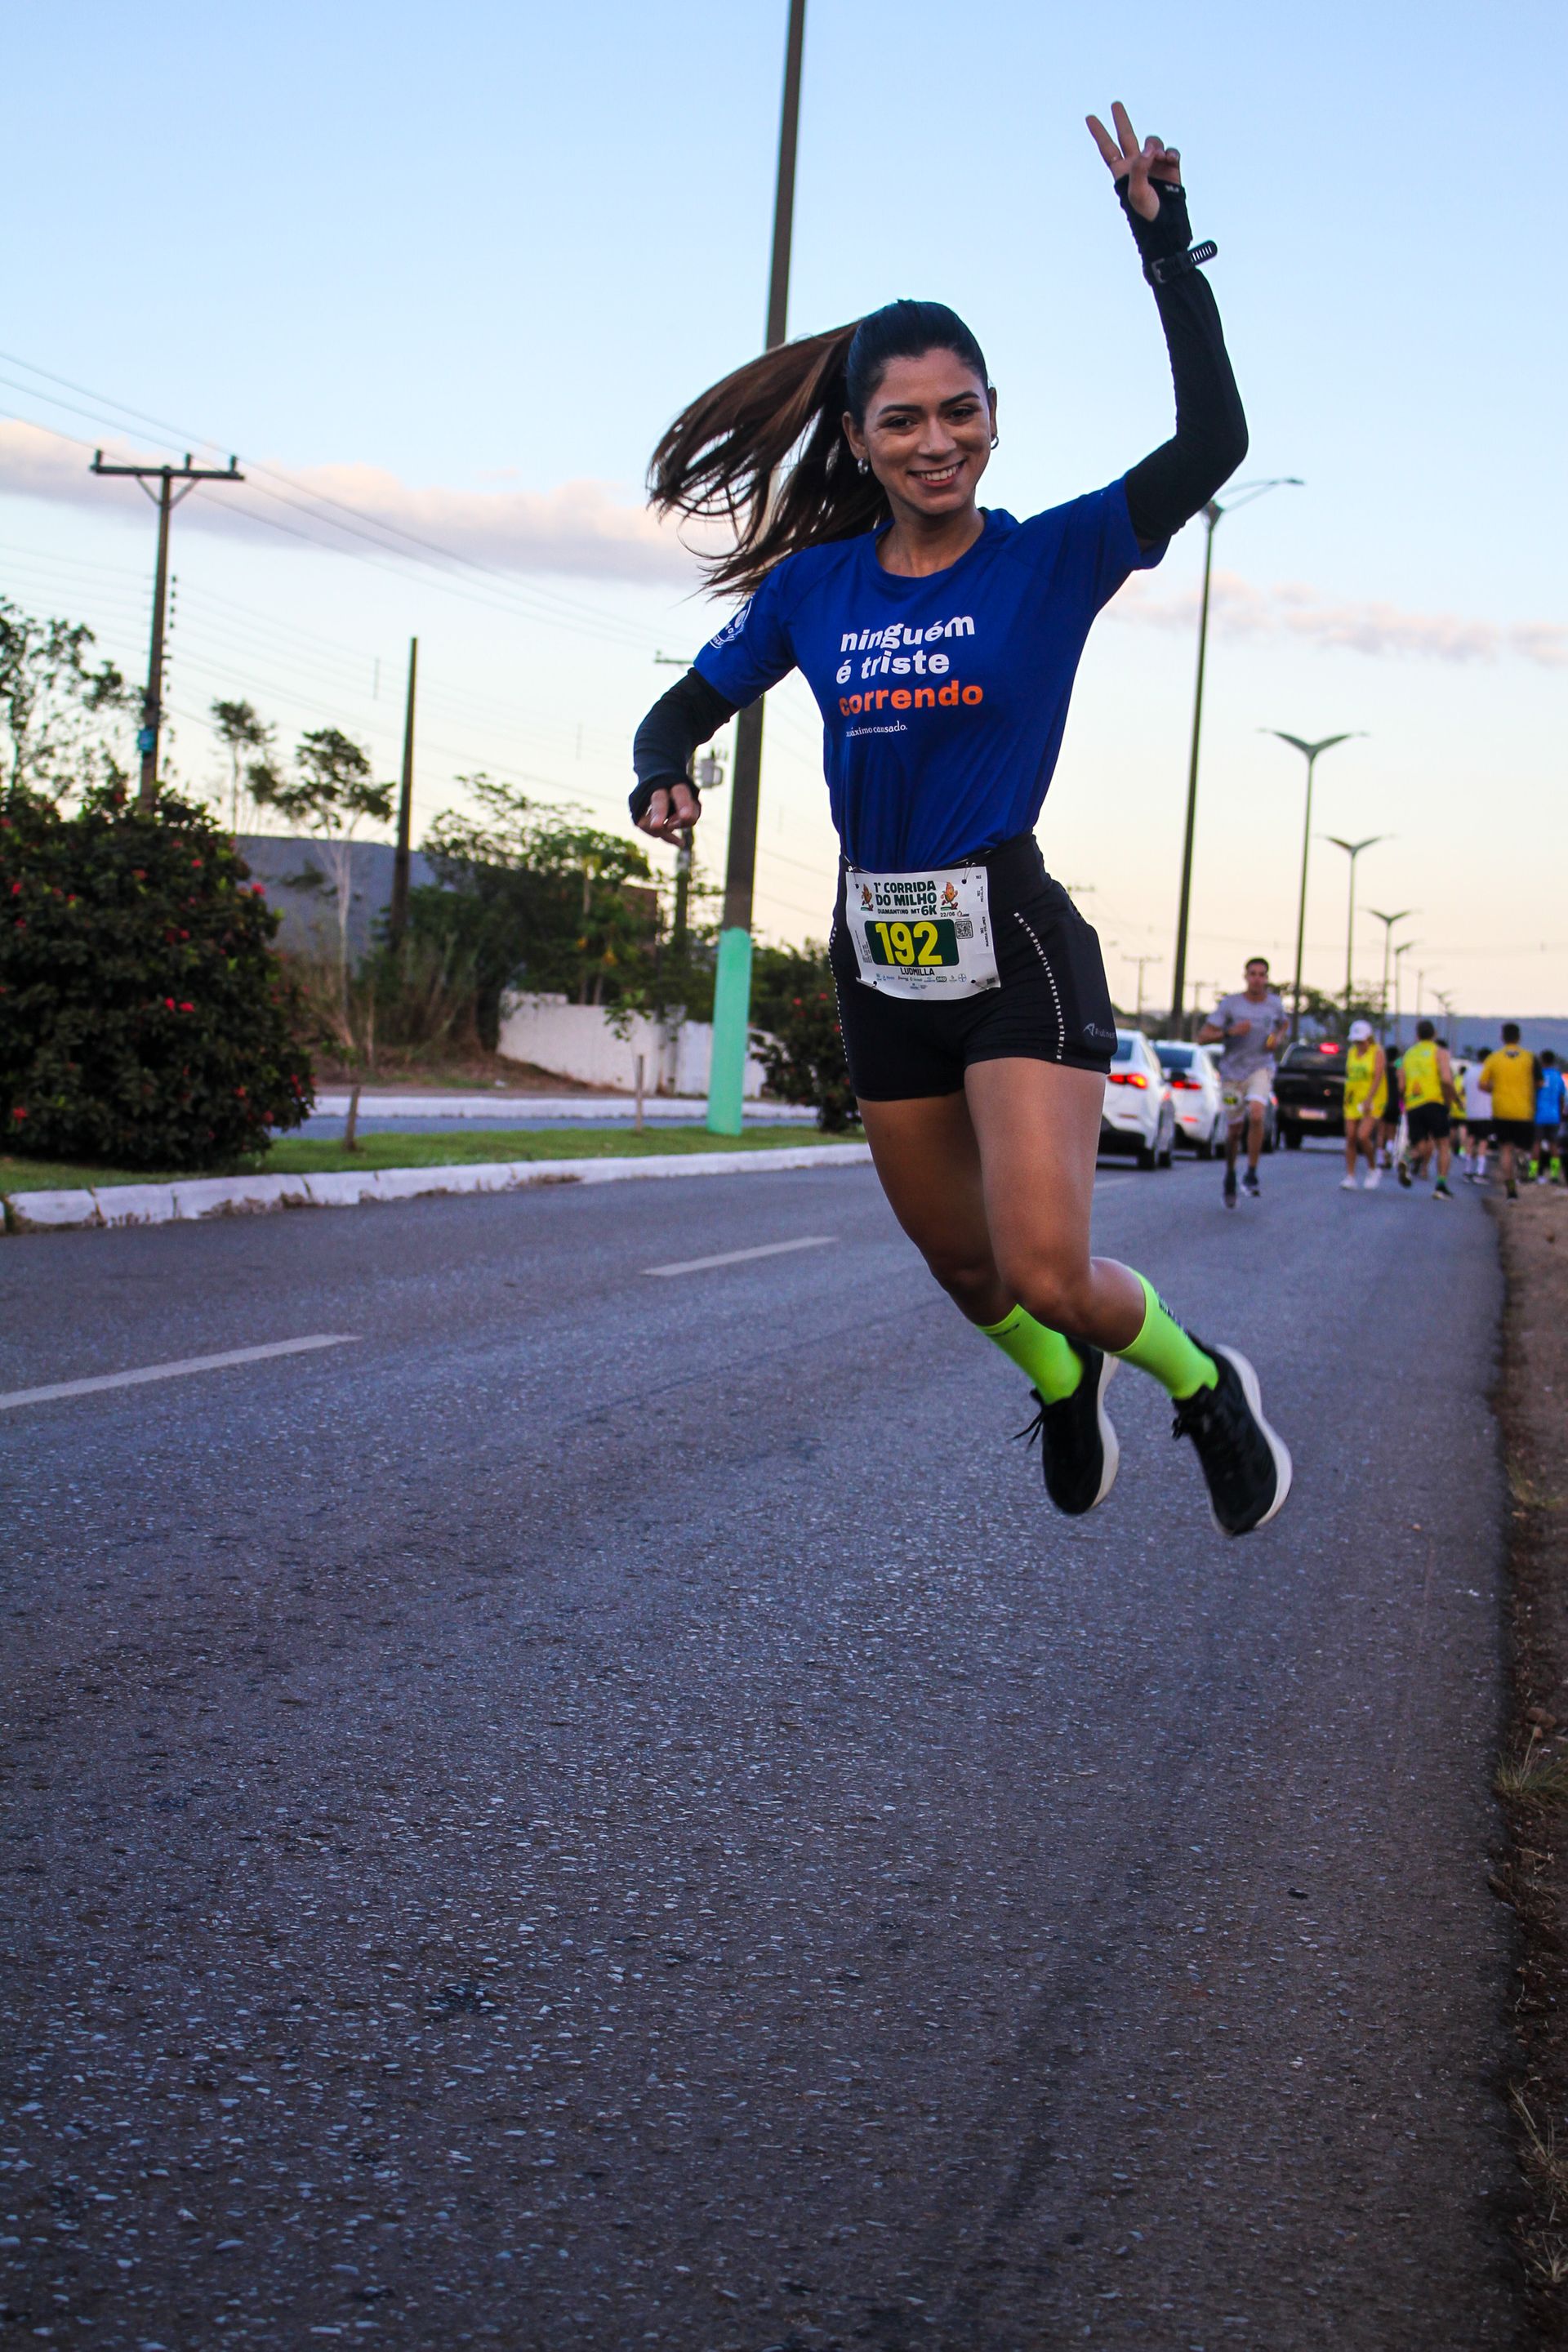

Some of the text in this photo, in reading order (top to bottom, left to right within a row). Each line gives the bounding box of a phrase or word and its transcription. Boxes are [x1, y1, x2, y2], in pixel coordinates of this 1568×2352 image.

[840, 616, 975, 653] ninguém
[835, 649, 950, 684] é triste
[839, 679, 983, 717] correndo
[884, 880, 937, 893] CORRIDA
[875, 892, 938, 906] DO MILHO
[920, 904, 938, 916] 6K
[875, 921, 942, 966] 192
[900, 967, 935, 976] LUDMILLA
